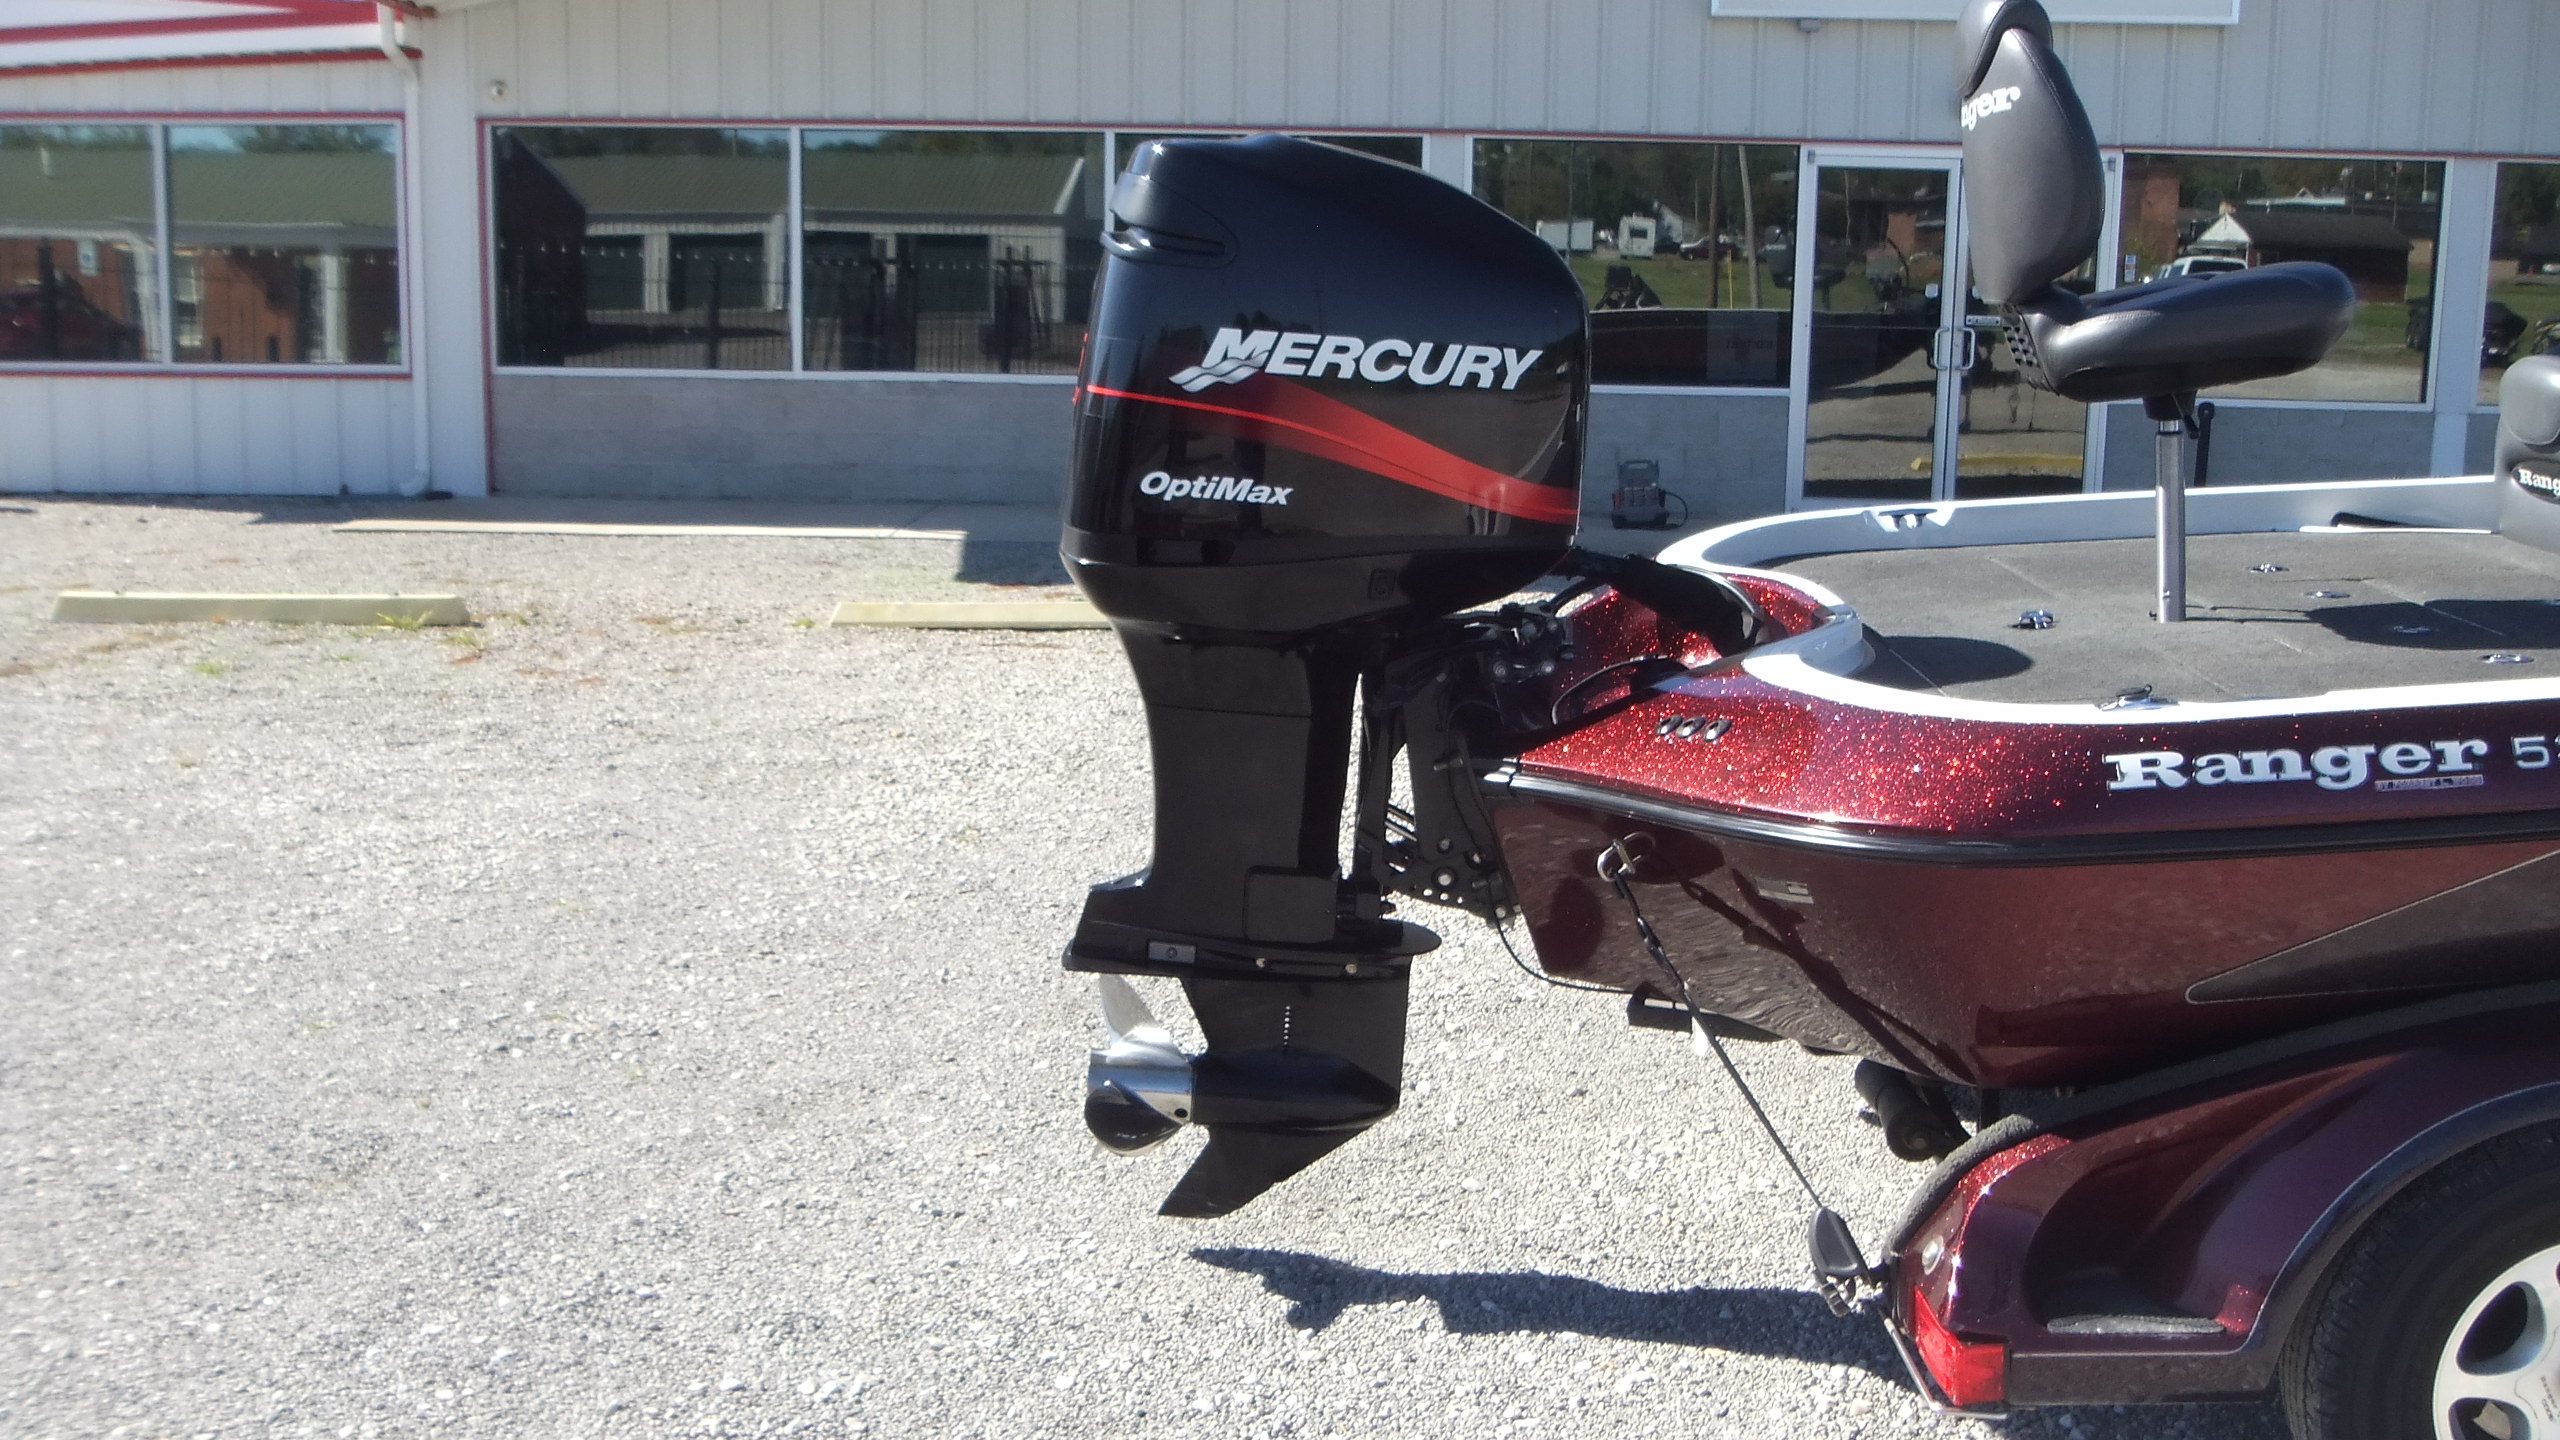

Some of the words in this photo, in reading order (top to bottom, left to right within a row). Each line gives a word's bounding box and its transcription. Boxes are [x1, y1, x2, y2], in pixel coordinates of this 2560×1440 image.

[1169, 327, 1543, 392] MERCURY
[1140, 471, 1294, 505] OptiMax
[2102, 739, 2488, 790] Ranger
[2511, 736, 2560, 769] 5
